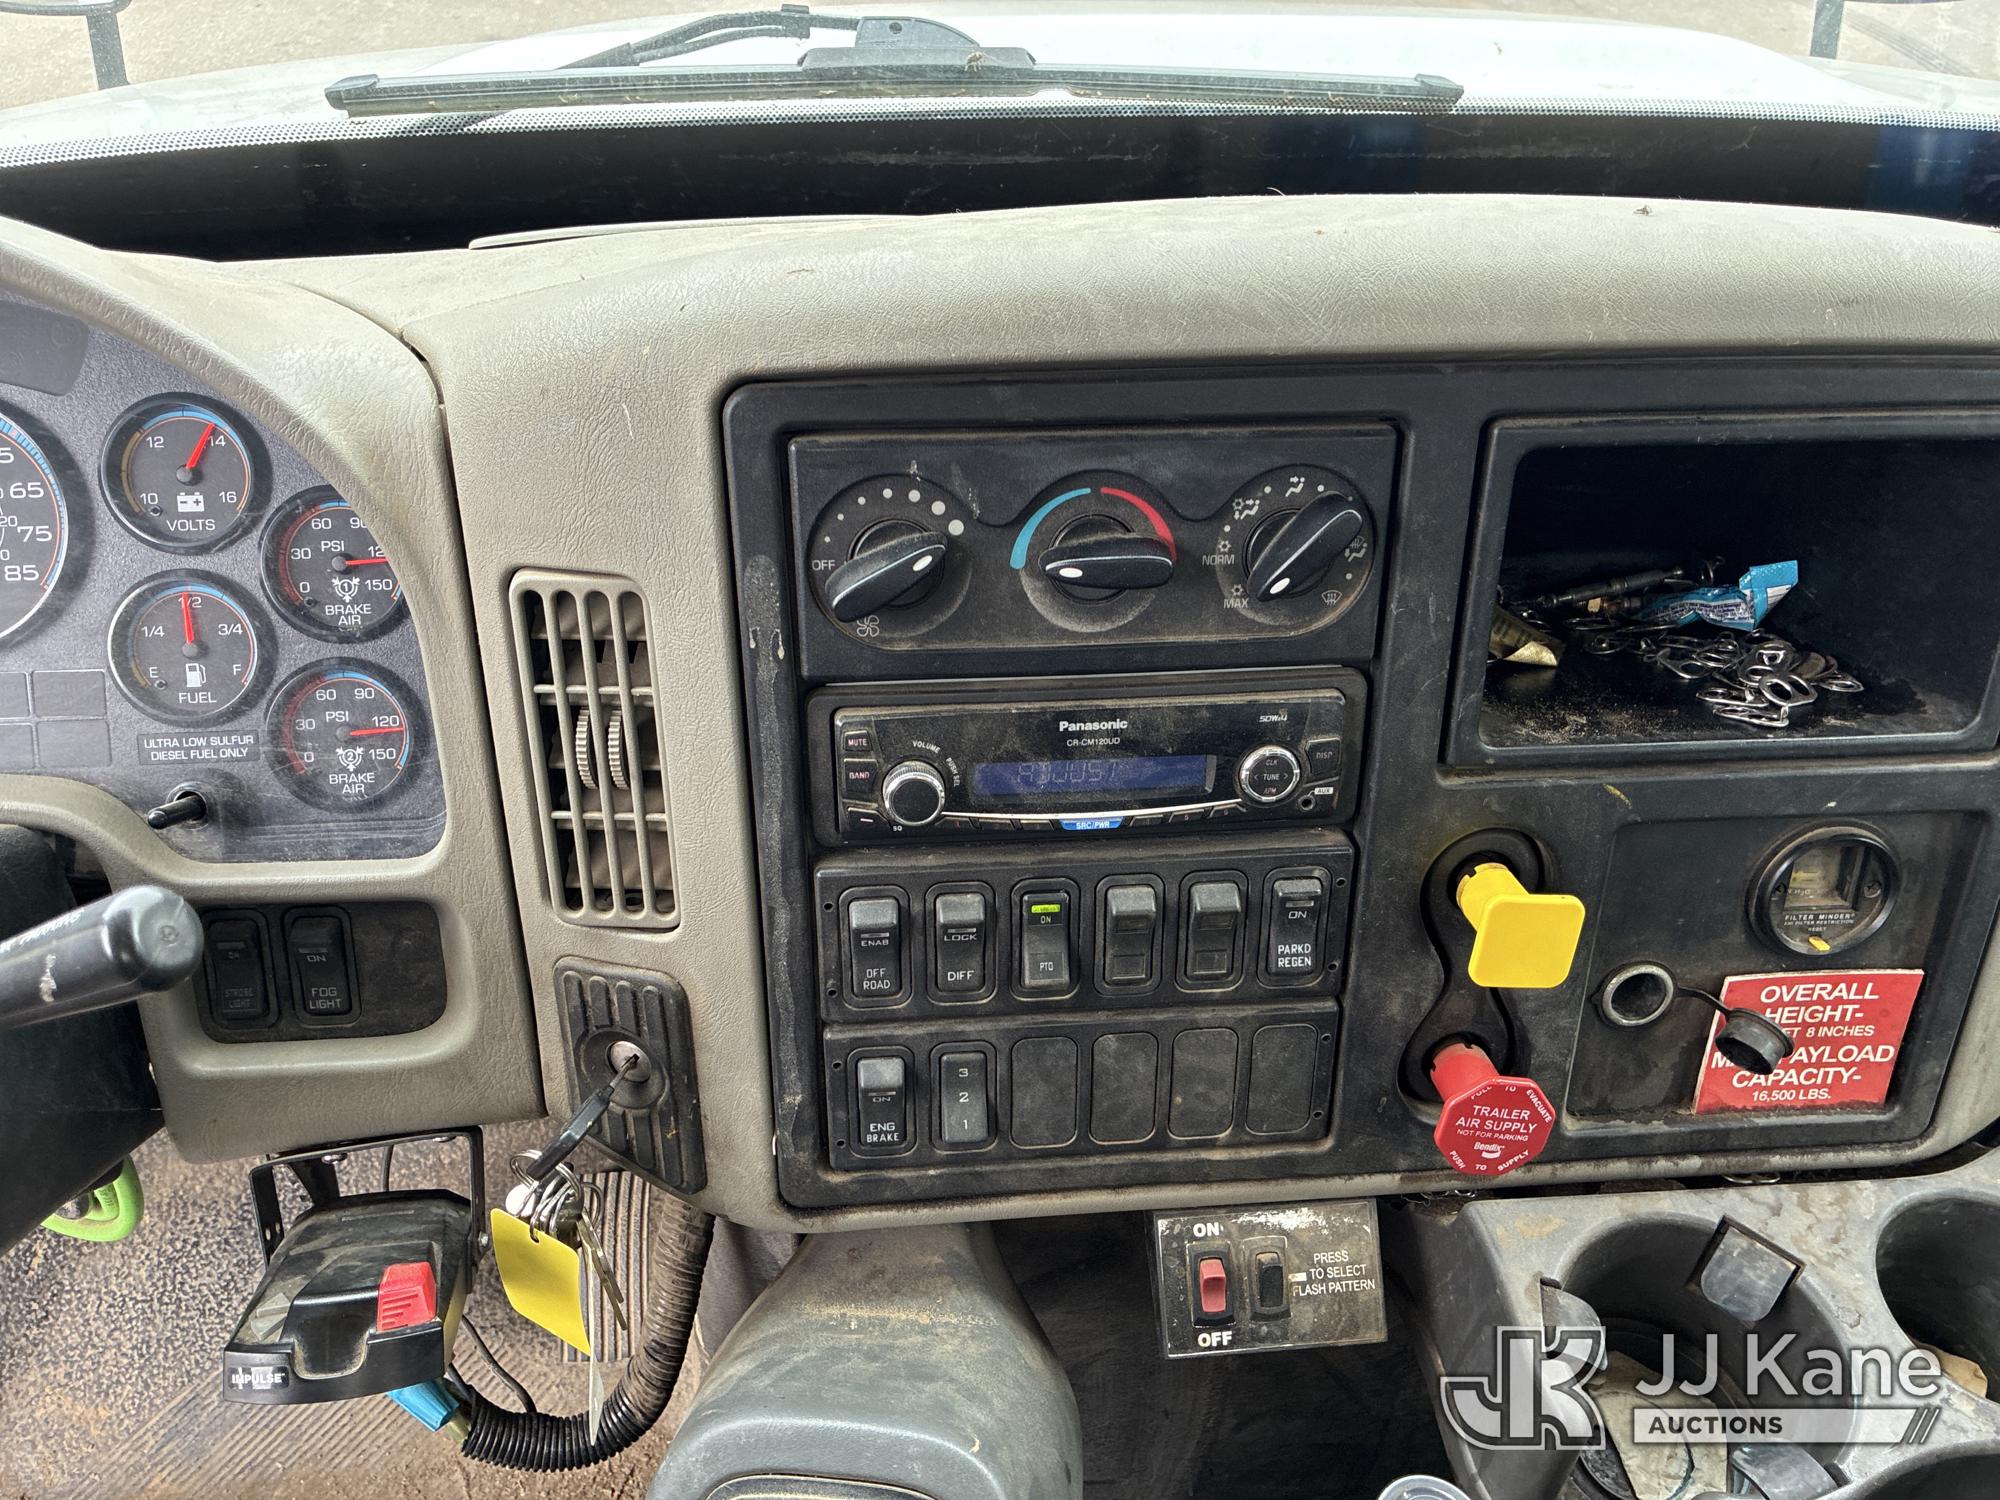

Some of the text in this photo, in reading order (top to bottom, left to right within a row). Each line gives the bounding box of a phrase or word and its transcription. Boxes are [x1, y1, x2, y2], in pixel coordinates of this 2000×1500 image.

[146, 436, 164, 448] 12
[208, 436, 226, 447] 14
[9, 482, 44, 498] 65
[140, 493, 158, 505] 10
[219, 491, 237, 503] 16
[166, 519, 216, 532] VOLTS
[311, 518, 332, 529] 60
[17, 525, 52, 542] 75
[321, 541, 345, 552] PSI
[291, 548, 311, 560] 30
[1202, 554, 1235, 566] NORM
[812, 560, 835, 571] OFF
[4, 565, 39, 581] 85
[300, 582, 310, 593] 0
[365, 579, 393, 591] 150
[325, 603, 372, 616] BRAKE
[1223, 598, 1248, 609] MAX
[338, 615, 362, 626] AIR
[141, 625, 165, 638] 1/4
[218, 623, 243, 636] 3/4
[150, 666, 158, 679] E
[233, 664, 242, 676] F
[178, 691, 217, 704] FUEL
[316, 689, 336, 701] 60
[354, 687, 375, 699] 90
[325, 711, 349, 723] PSI
[372, 715, 400, 728] 120
[296, 718, 316, 731] 30
[1059, 718, 1128, 732] Panasonic
[144, 734, 254, 749] ULTRA LOW SULFUR
[848, 738, 867, 746] MUTE
[912, 740, 941, 754] VOLUME
[1066, 737, 1121, 747] CR-CM120UD
[151, 747, 248, 762] DIESEL FUEL ONLY
[304, 751, 315, 763] 0
[369, 748, 396, 760] 150
[1316, 751, 1333, 759] DISP
[1265, 758, 1279, 766] CLK
[329, 772, 375, 785] BRAKE
[849, 771, 870, 780] BAND
[1263, 773, 1280, 781] TUNE
[342, 783, 365, 794] AIR
[1076, 820, 1111, 830] SRC/PWR
[1040, 916, 1052, 924] ON
[1288, 910, 1307, 919] ON
[861, 939, 889, 947] ENAB
[944, 934, 977, 942] LOCK
[1278, 943, 1312, 955] PARKD
[307, 954, 326, 962] ON
[1278, 956, 1312, 968] REGEN
[1039, 961, 1054, 971] PTO
[866, 967, 886, 979] OFF
[947, 970, 975, 981] DIFF
[863, 979, 891, 991] ROAD
[311, 986, 337, 997] FOG
[1760, 982, 1879, 1003] OVERALL
[309, 998, 342, 1010] LIGHT
[1764, 1005, 1864, 1024] HEIGHT-
[1806, 1027, 1815, 1038] 8
[1818, 1025, 1875, 1037] INCHES
[1778, 1045, 1895, 1065] AYLOAD
[958, 1068, 969, 1077] 3
[1732, 1066, 1862, 1088] CAPACITY-
[959, 1091, 969, 1102] 2
[1752, 1088, 1832, 1102] 16,500 LBS.
[1526, 1089, 1553, 1124] EVACUATE
[1473, 1105, 1531, 1121] TRAILER
[869, 1122, 896, 1132] ENG
[962, 1119, 968, 1130] 1
[1455, 1116, 1538, 1134] AIR SUPPLY
[866, 1132, 899, 1143] BRAKE
[1456, 1129, 1529, 1142] NOT FOR PARKING
[1473, 1141, 1501, 1152] Bendix
[1449, 1149, 1530, 1172] PUSH TO SUPPLY
[1193, 1222, 1220, 1238] ON
[1313, 1249, 1350, 1264] PRESS
[1309, 1263, 1367, 1280] TO SELECT
[1292, 1278, 1376, 1297] FLASH PATTERN
[1198, 1330, 1233, 1347] OFF
[231, 1372, 284, 1385] IMPULSE
